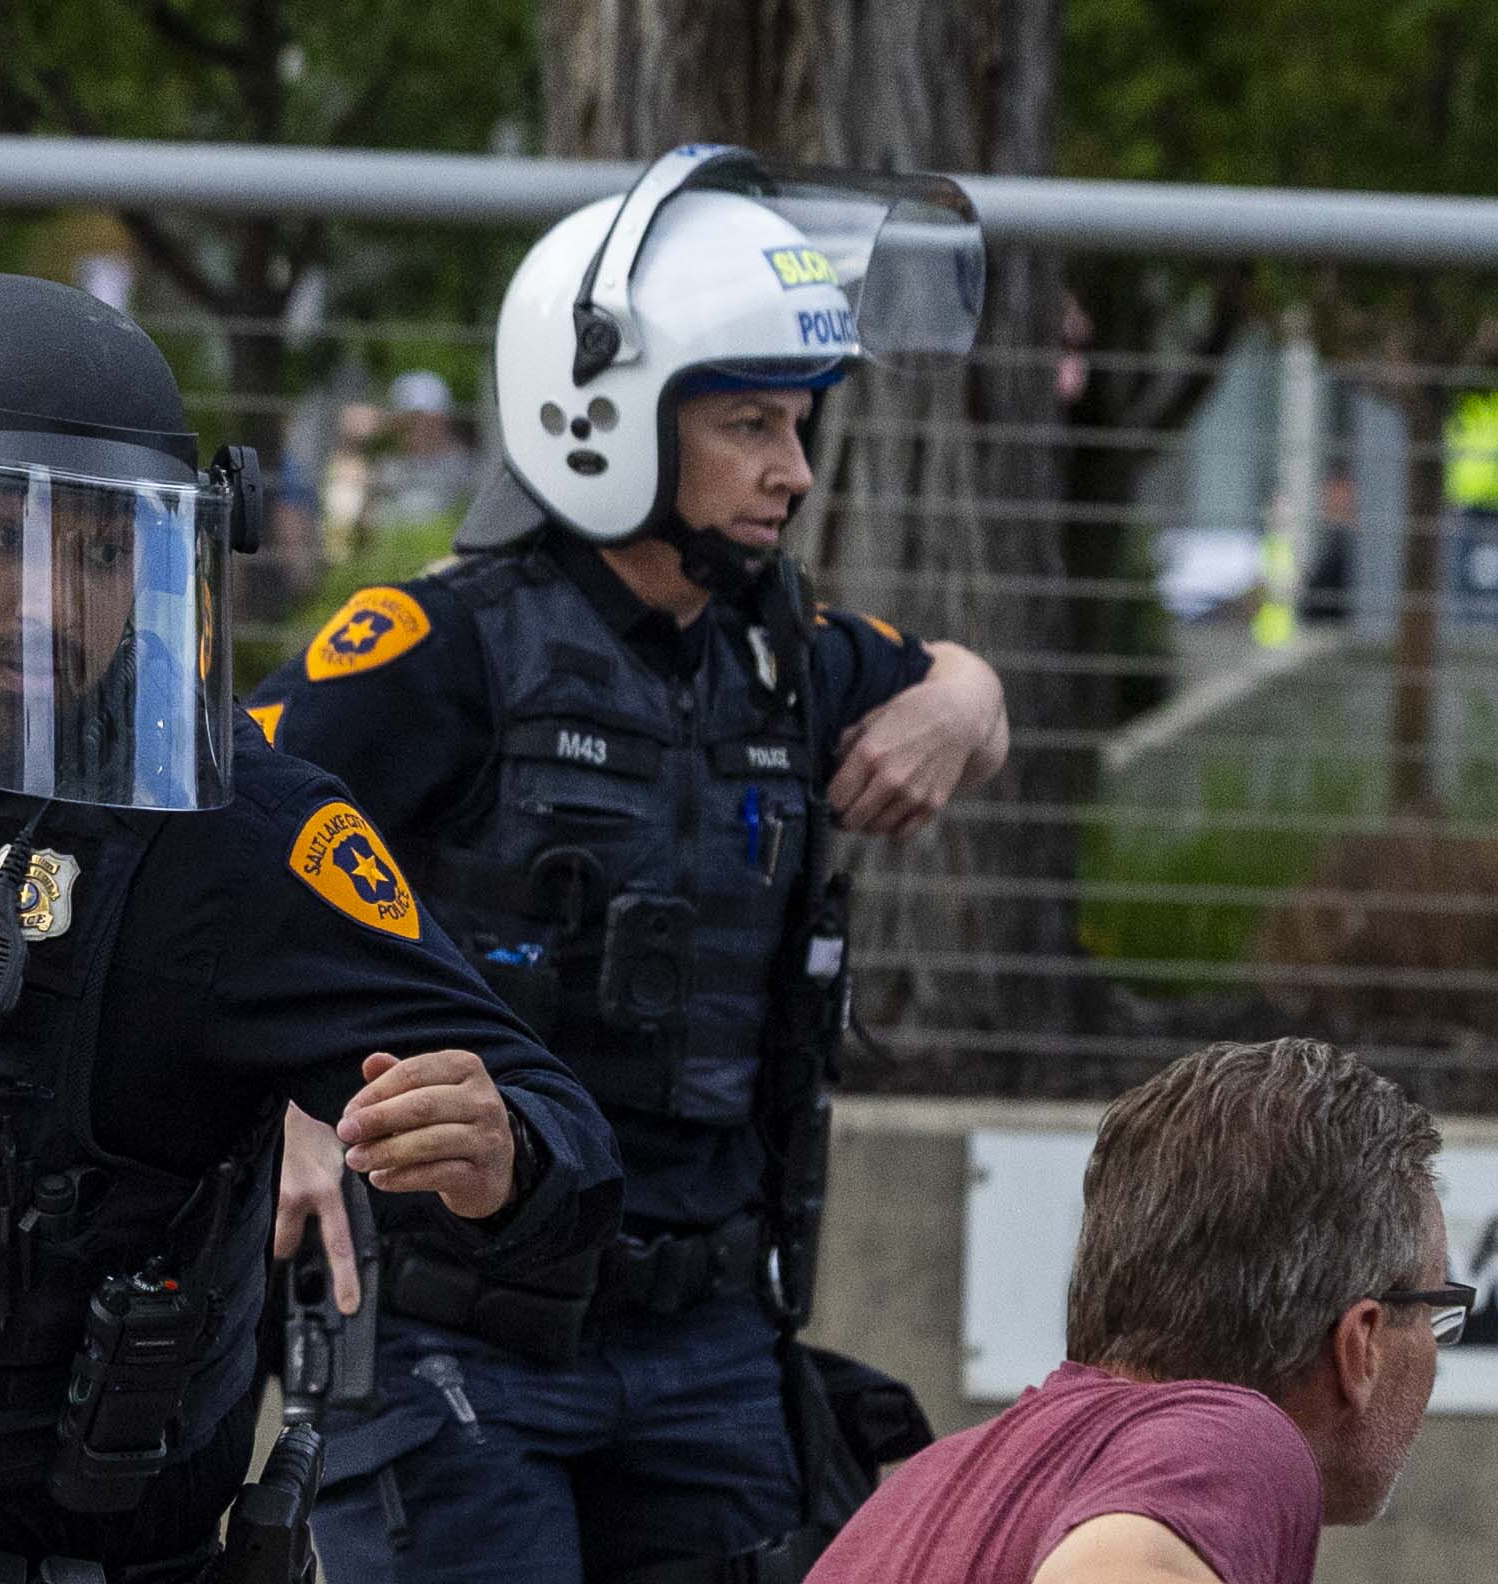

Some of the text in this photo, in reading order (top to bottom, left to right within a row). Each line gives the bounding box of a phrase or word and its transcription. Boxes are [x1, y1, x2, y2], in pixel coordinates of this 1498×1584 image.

[797, 309, 859, 346] POLIC
[747, 745, 791, 770] POLICE
[304, 812, 369, 876] SALT LAKE CITY
[377, 889, 410, 921] POLICE
